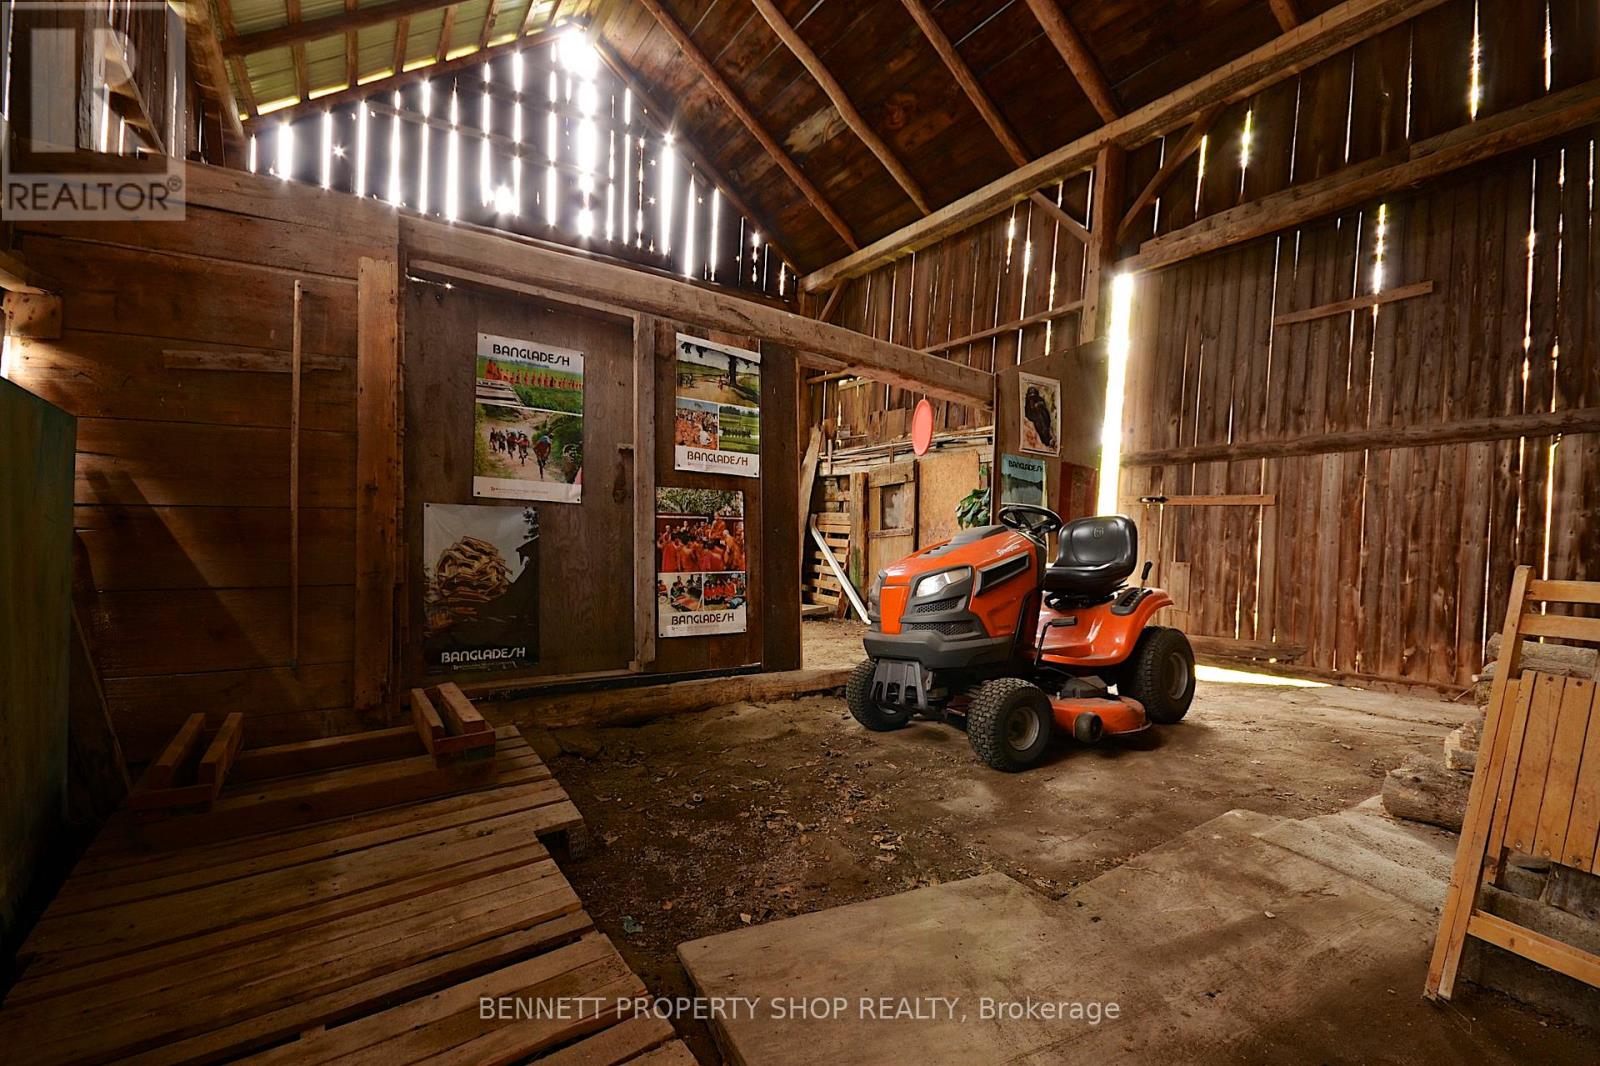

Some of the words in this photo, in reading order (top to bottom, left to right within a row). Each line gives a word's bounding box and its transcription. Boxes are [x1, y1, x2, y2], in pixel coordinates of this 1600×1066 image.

[492, 343, 570, 367] BANGLADESH
[687, 450, 749, 466] BANGLADESH
[671, 613, 735, 626] BANGLADESH
[440, 646, 527, 664] BANGLADESH
